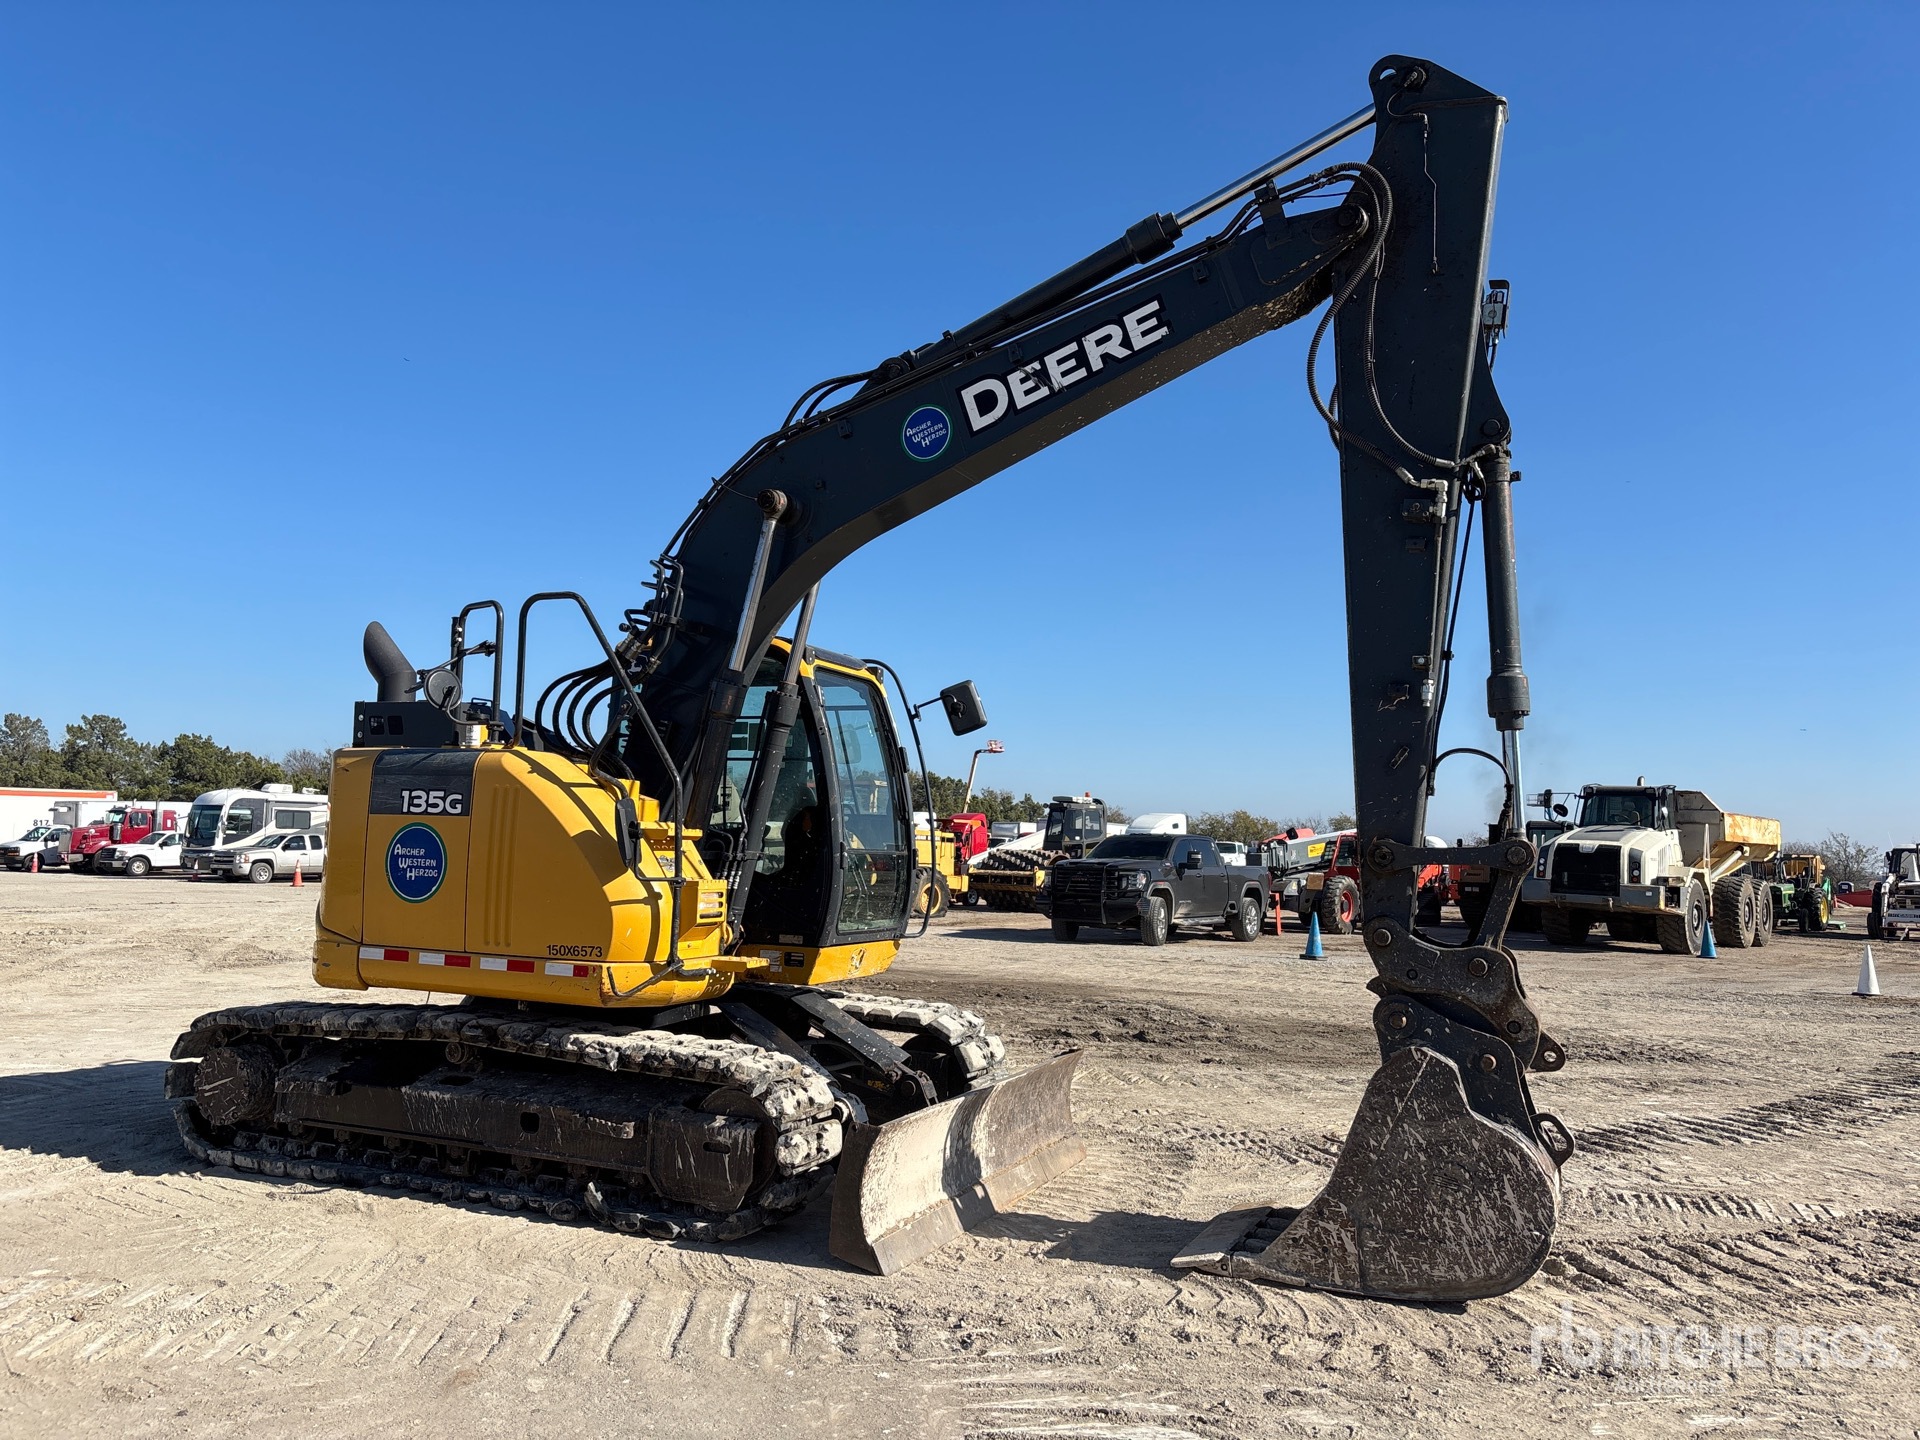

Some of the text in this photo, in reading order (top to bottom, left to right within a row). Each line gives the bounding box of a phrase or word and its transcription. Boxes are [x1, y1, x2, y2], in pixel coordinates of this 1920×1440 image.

[960, 299, 1170, 432] DEERE
[906, 420, 931, 437] ARCHER
[912, 422, 943, 443] WESTERN
[921, 428, 947, 447] HERZOG
[401, 790, 463, 814] 135G
[33, 819, 50, 827] 817
[394, 843, 426, 857] ARCHER
[398, 857, 437, 869] WESTERN
[406, 867, 438, 881] HERZOG
[546, 944, 603, 958] 150X6573
